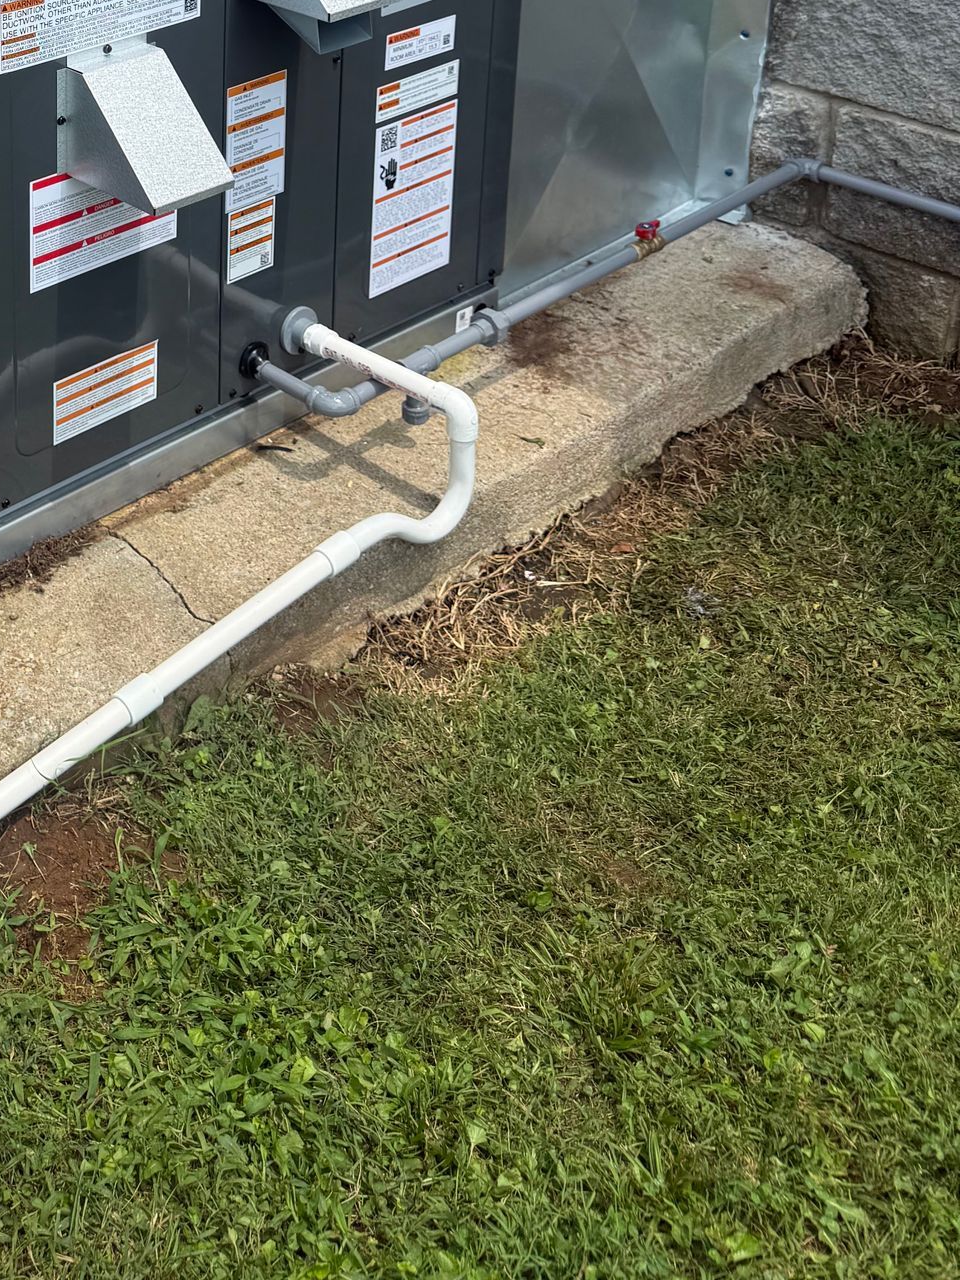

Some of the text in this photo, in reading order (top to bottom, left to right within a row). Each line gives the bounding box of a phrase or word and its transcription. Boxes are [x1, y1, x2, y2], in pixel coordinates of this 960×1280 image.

[2, 13, 12, 22] BE
[15, 5, 45, 18] IGNITION
[48, 6, 71, 18] OTHER
[74, 1, 91, 11] THAN
[3, 30, 17, 39] USE
[20, 25, 38, 35] WITH
[40, 20, 53, 29] THE
[55, 12, 85, 25] SPECIFIC
[394, 28, 419, 43] WARNING
[390, 54, 404, 62] ROOM
[234, 103, 259, 115] CONDENSATE
[94, 199, 115, 211] DANGER
[94, 229, 115, 241] PELIGRO
